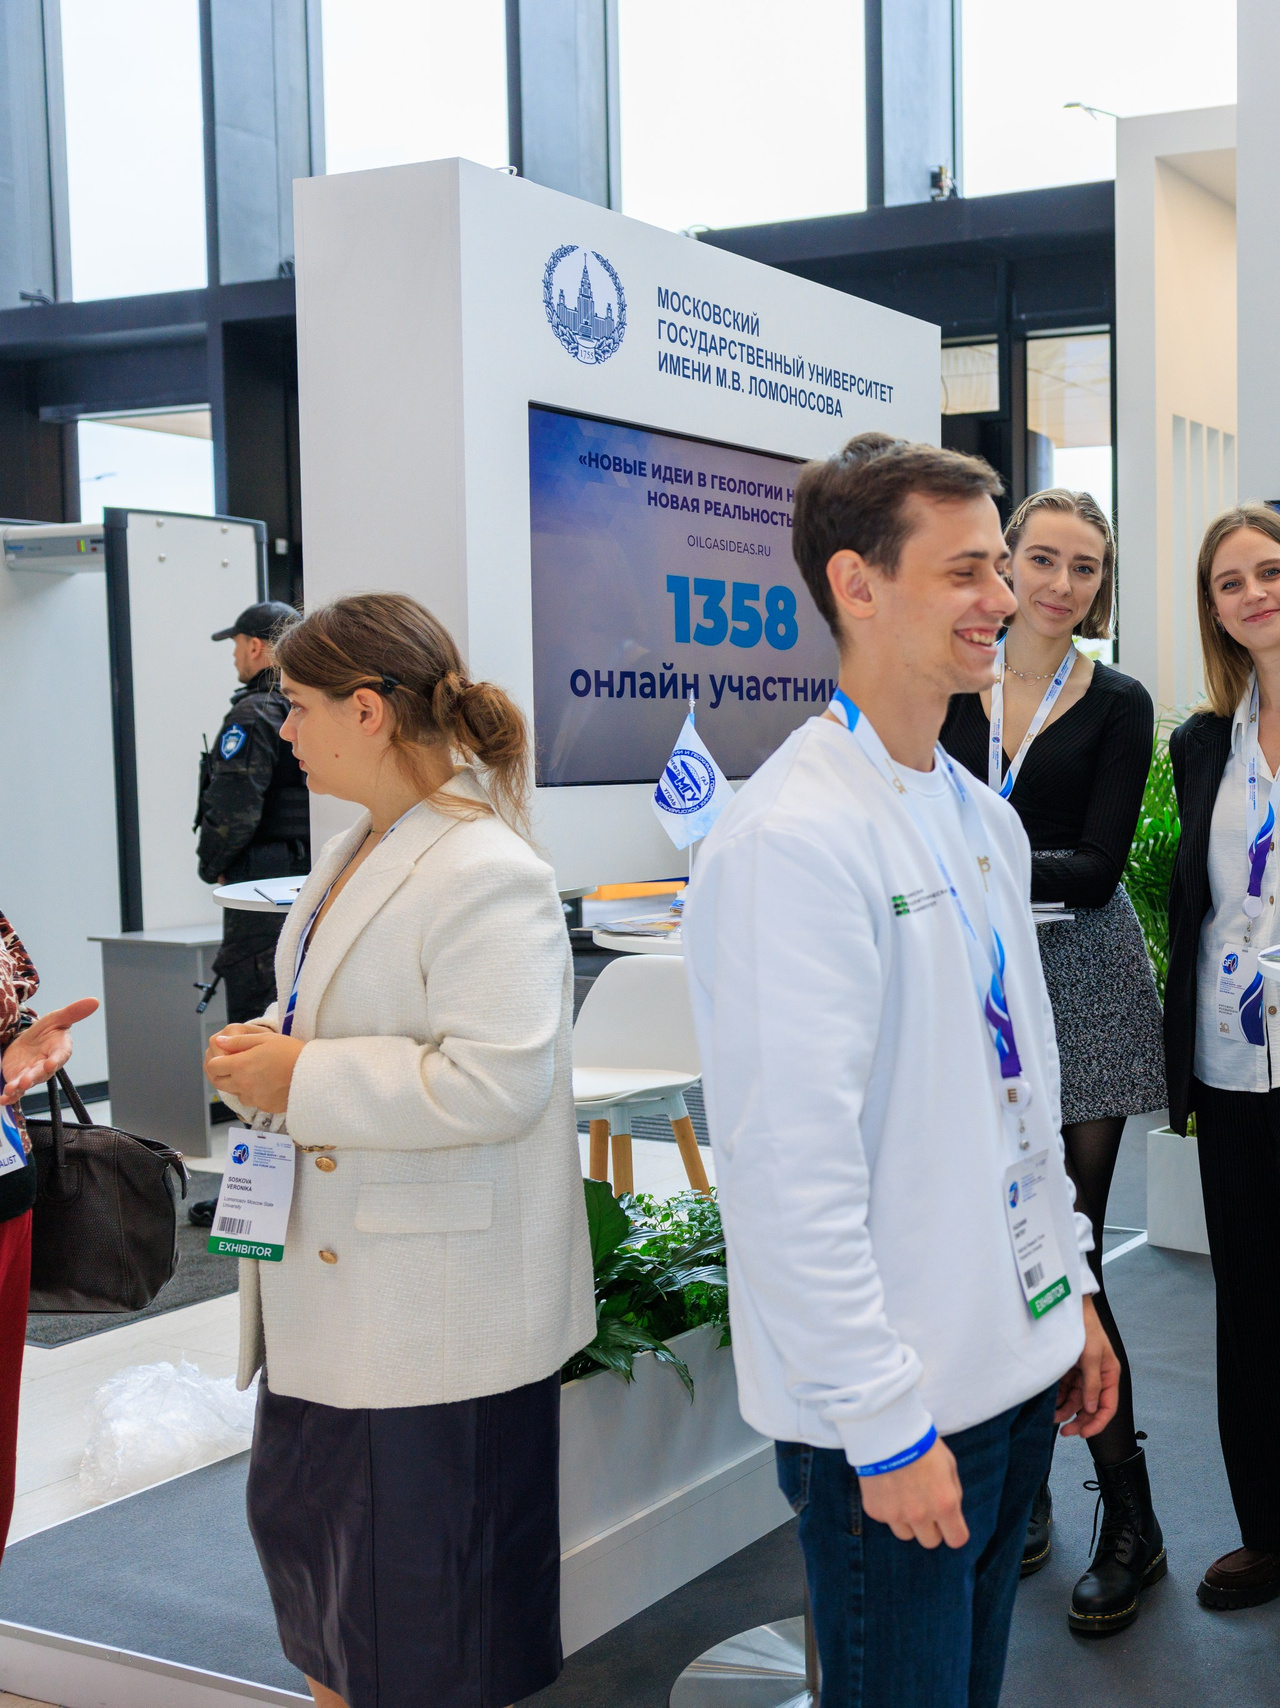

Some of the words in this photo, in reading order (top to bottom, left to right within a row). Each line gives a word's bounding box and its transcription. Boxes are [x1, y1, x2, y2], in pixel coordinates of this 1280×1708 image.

[657, 286, 760, 337] МОСКОВСКИЙ
[657, 319, 804, 379] ГОСУДАРСТВЕННЫЙ
[808, 362, 893, 403] УНИВЕРСИТЕТ
[658, 351, 711, 384] ИМЕНИ
[716, 366, 745, 393] М.В.
[748, 375, 843, 418] ЛОМОНОСОВА
[578, 451, 648, 477] «НОВЫЕ
[651, 463, 694, 486] ИДЕИ
[697, 472, 707, 487] В
[710, 474, 783, 501] ГЕОЛОГИИ
[647, 490, 700, 513] НОВАЯ
[687, 535, 771, 556] OILGASIDEAS.RU
[666, 574, 799, 650] 1358
[569, 662, 699, 700] онлайн
[674, 775, 700, 801] МГУ
[226, 1183, 252, 1192] VERONIKA
[228, 1176, 252, 1185] SOSKOVA
[218, 1241, 272, 1257] EXHIBITOR
